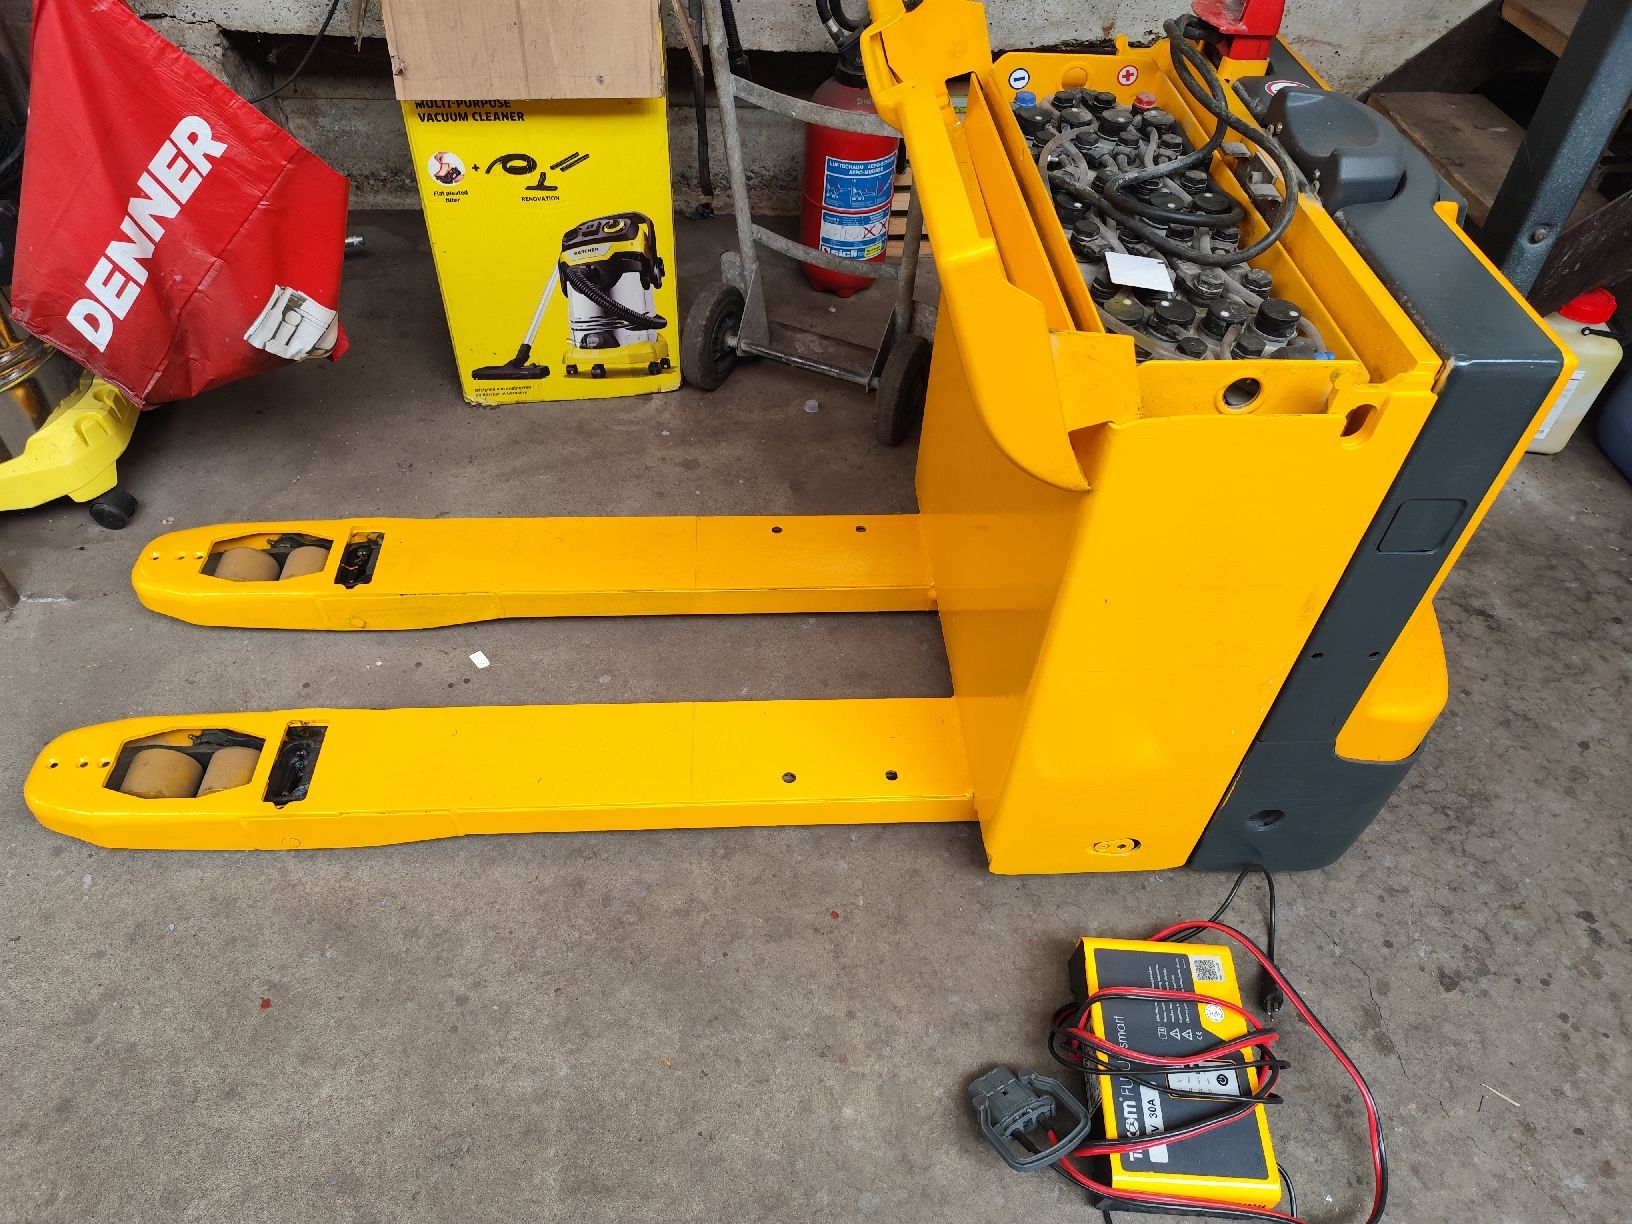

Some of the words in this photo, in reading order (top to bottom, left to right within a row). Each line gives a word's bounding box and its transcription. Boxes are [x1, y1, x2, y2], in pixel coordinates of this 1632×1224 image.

[414, 99, 511, 109] MULTI-PURPOSE
[417, 112, 469, 123] VACUUM
[472, 111, 525, 122] CLEANER
[66, 115, 228, 353] DENNER
[1113, 1015, 1129, 1049] smart
[1147, 1098, 1159, 1119] 30A
